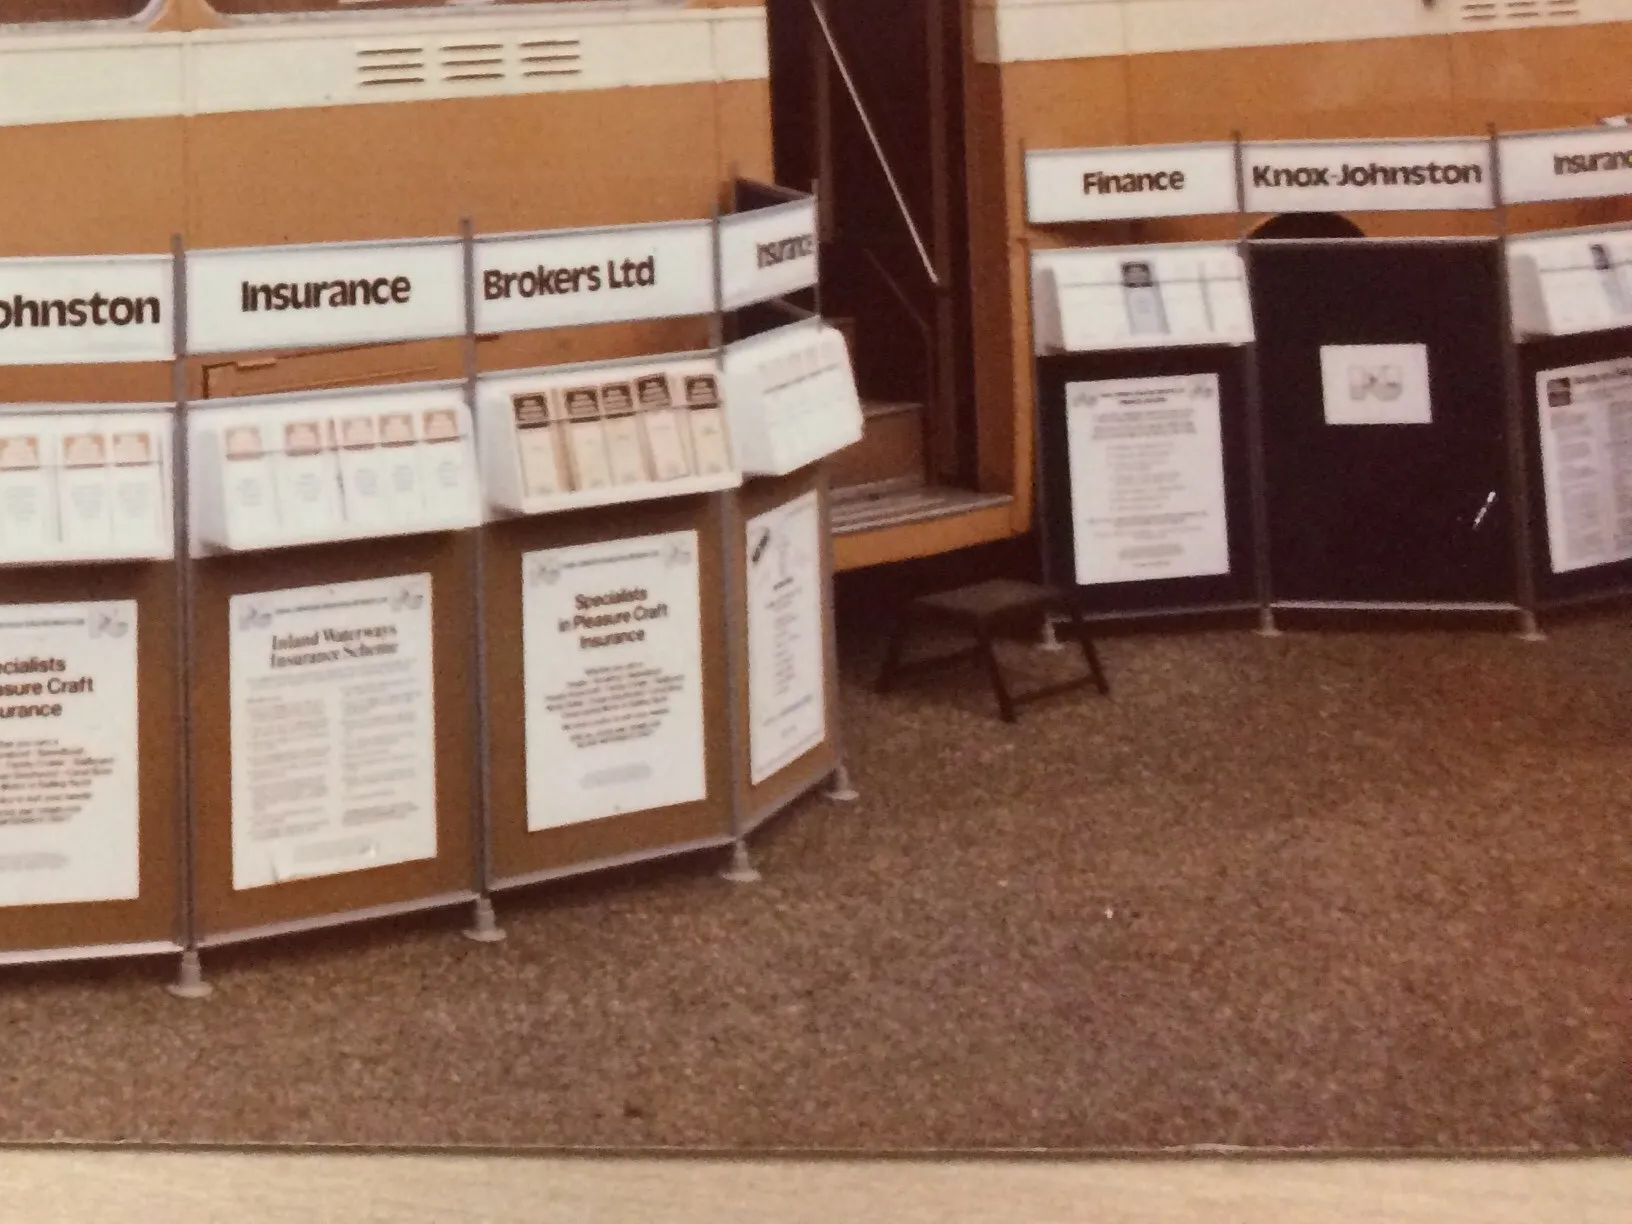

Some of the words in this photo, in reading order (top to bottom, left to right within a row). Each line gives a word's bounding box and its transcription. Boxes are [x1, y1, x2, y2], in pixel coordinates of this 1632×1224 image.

[1083, 170, 1185, 195] Finance
[1253, 162, 1482, 188] Knox-Johnston
[483, 264, 602, 301] Brokers
[607, 255, 656, 290] Ltd
[241, 276, 412, 313] Insurance
[46, 676, 94, 695] Craft
